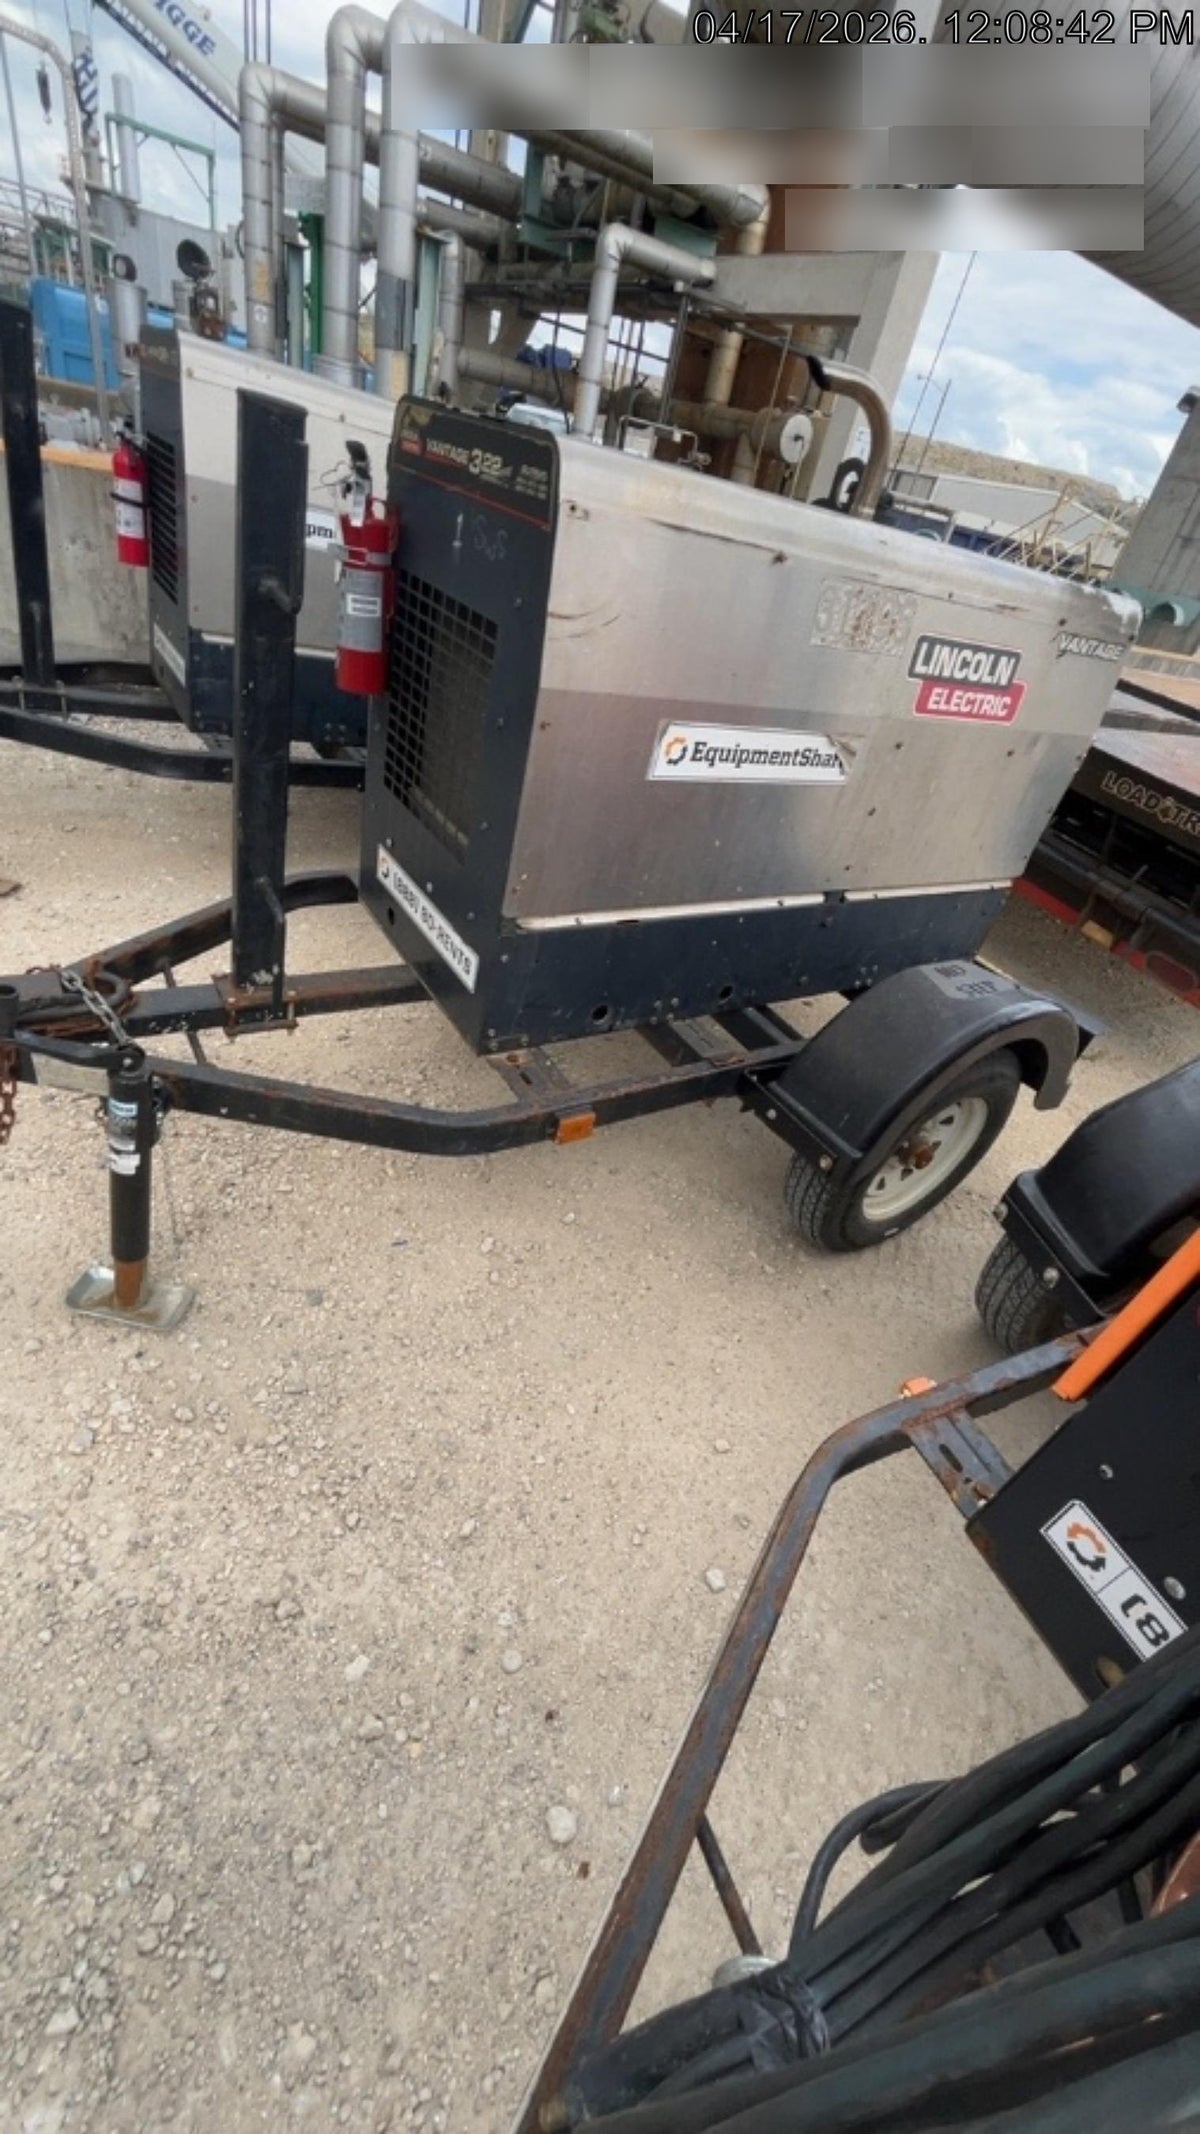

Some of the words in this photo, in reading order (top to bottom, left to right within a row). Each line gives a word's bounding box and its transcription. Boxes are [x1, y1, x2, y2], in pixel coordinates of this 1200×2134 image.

[914, 642, 1016, 686] LINCOLN
[926, 687, 1011, 717] ELECTRIC
[690, 741, 844, 769] EquipmentShar
[1100, 770, 1162, 814] LOAD
